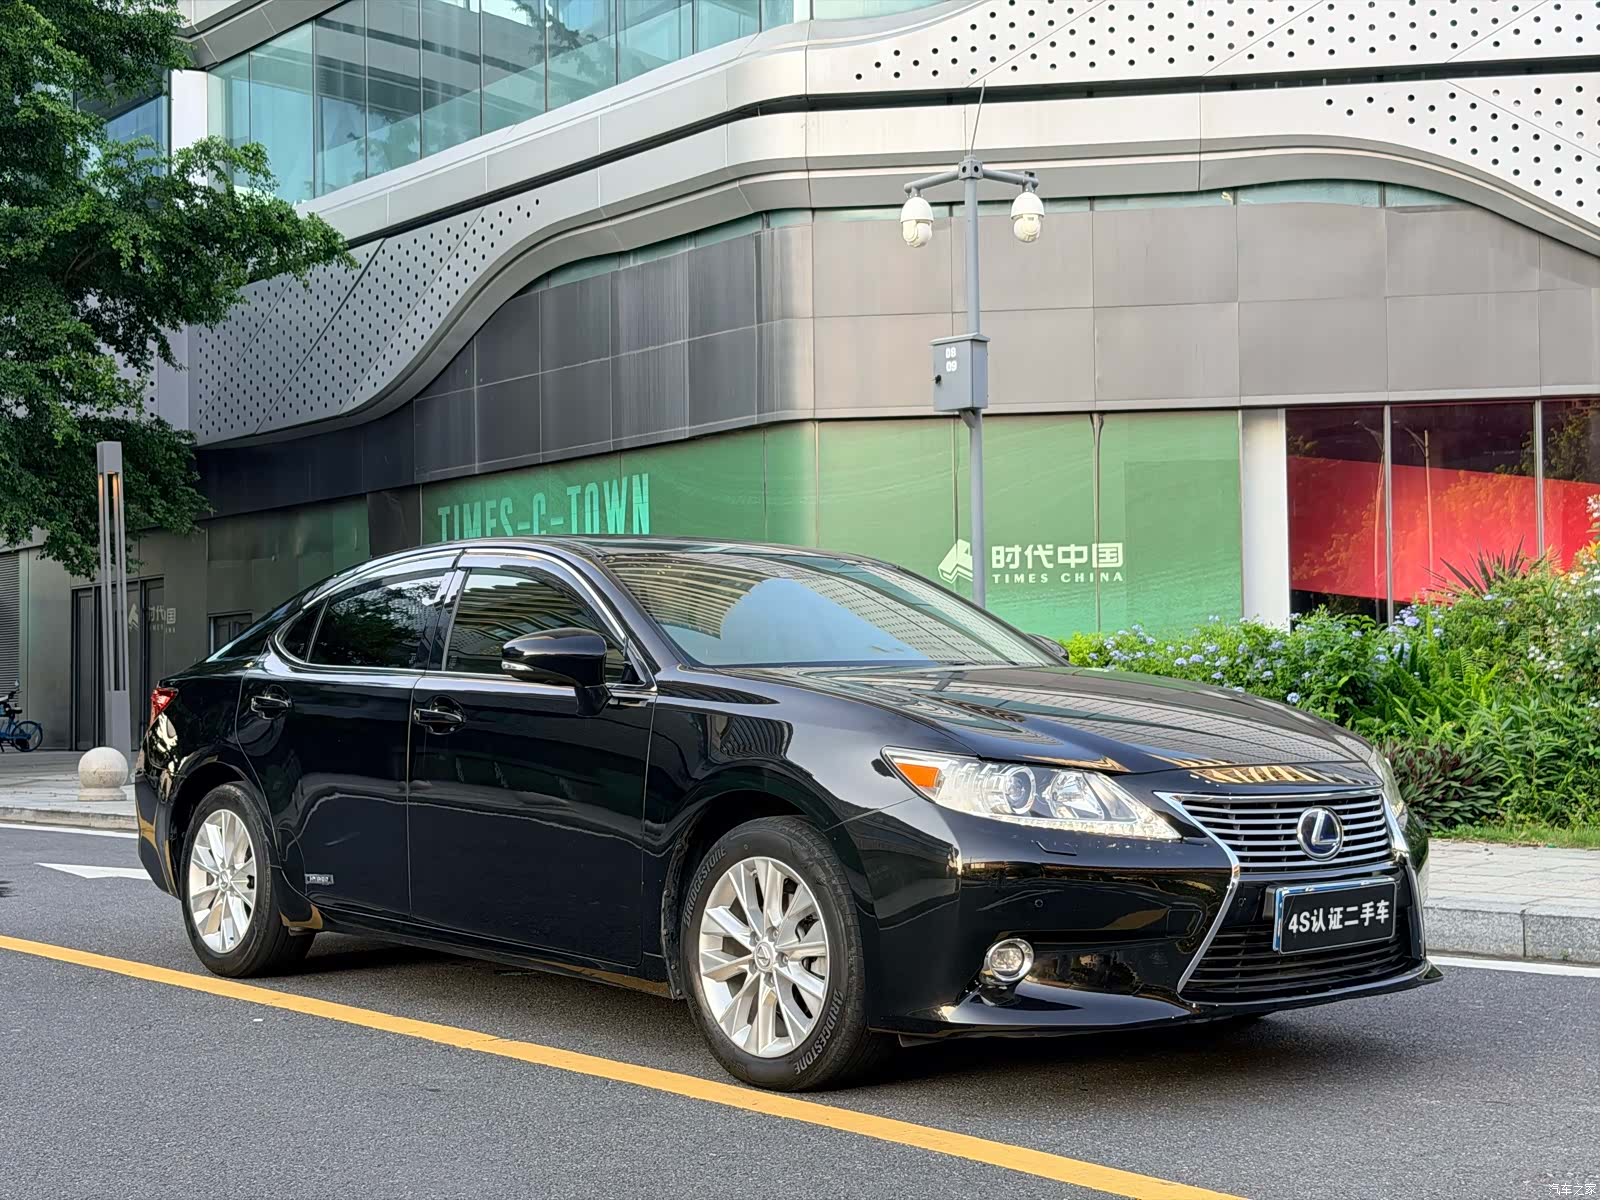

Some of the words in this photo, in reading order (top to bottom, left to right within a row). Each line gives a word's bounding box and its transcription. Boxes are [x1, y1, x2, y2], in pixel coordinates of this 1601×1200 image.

[946, 347, 957, 359] 08
[946, 360, 957, 372] 09
[991, 543, 1123, 568] 时代中国
[992, 573, 1048, 584] TIMES
[1060, 573, 1123, 583] CHINA
[684, 848, 728, 928] BRIDGESTONE
[1288, 900, 1389, 933] 4S认证二手车
[795, 989, 844, 1075] BRIDGESTONE
